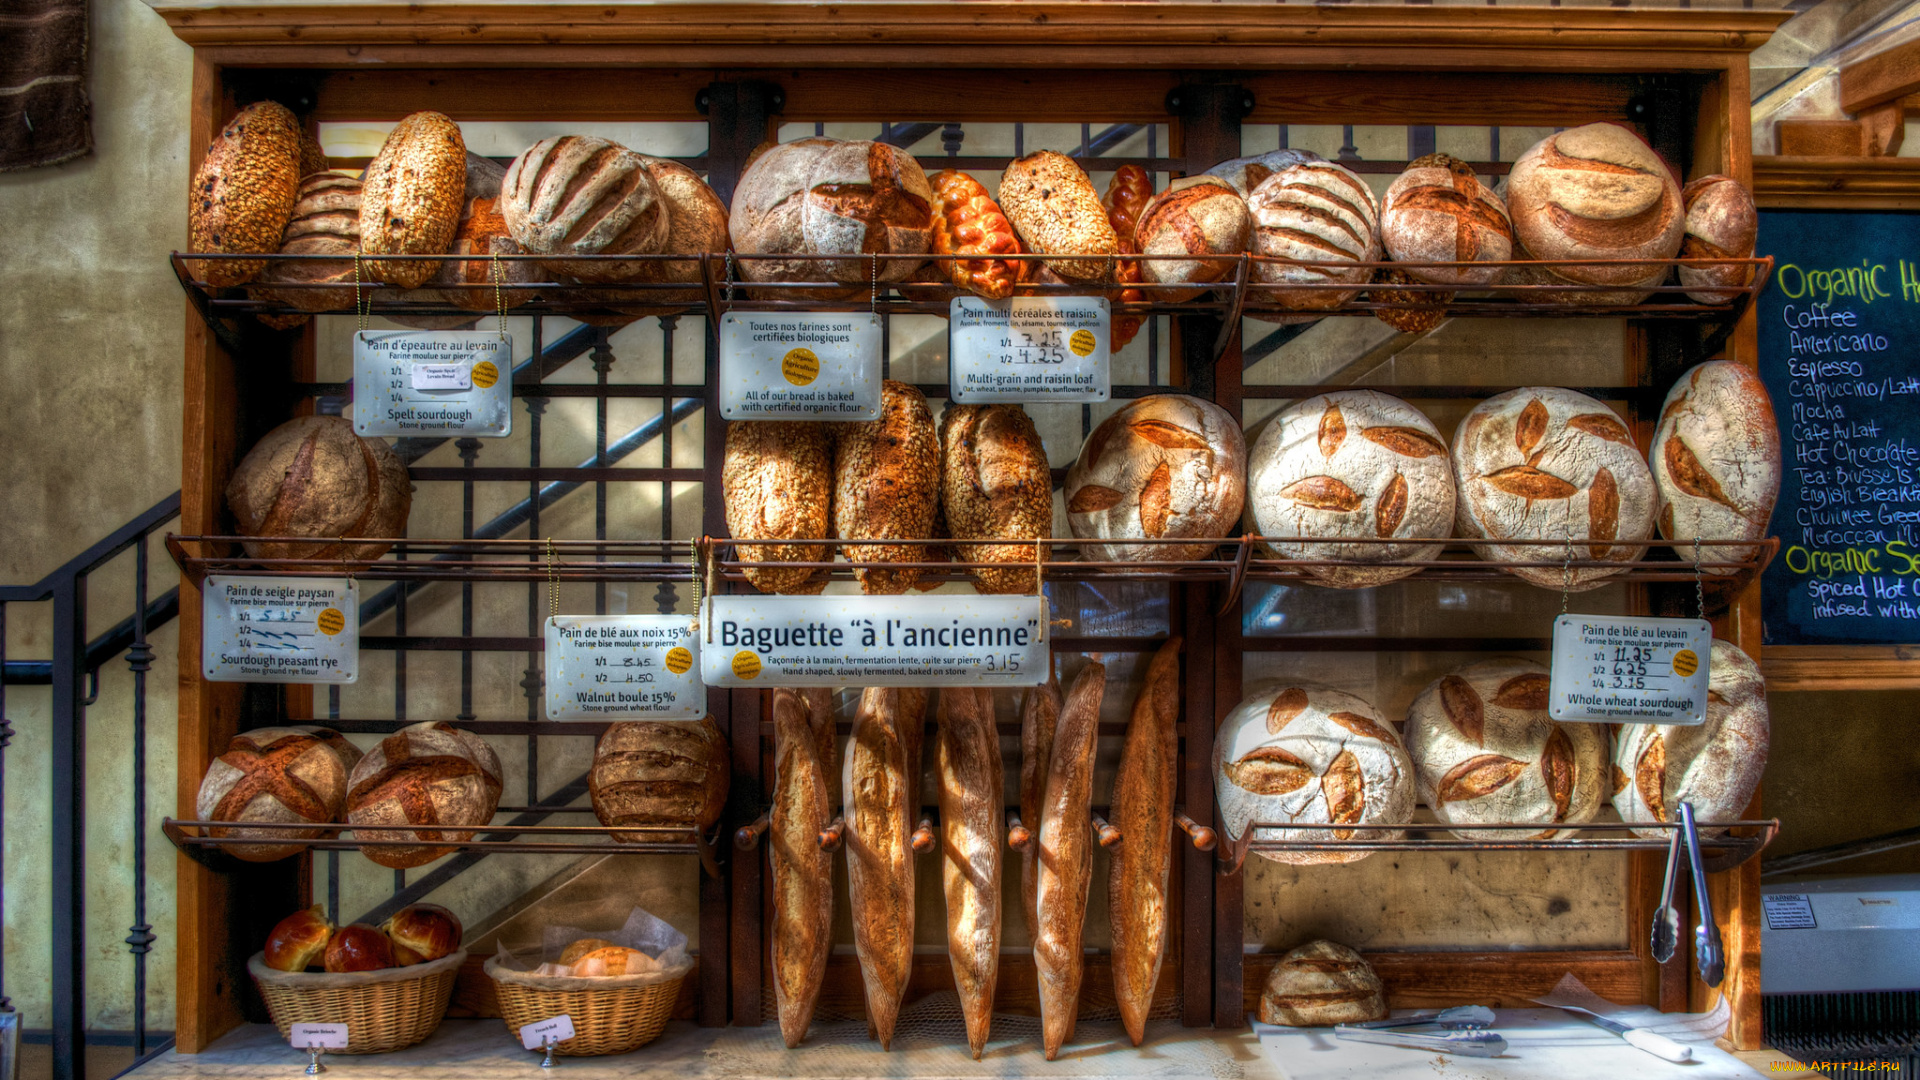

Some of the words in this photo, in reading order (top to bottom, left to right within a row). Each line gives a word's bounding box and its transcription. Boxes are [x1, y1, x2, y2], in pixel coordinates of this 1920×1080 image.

[1778, 258, 1890, 308] Organic
[963, 309, 983, 318] Pain
[986, 309, 1010, 318] multi
[1013, 309, 1052, 318] céréales
[1055, 310, 1063, 318] et
[1066, 310, 1097, 318] raisins
[1784, 303, 1857, 329] Coffee
[750, 322, 778, 331] Toutes
[799, 322, 830, 331] farines
[754, 333, 795, 342] certifiées
[798, 333, 849, 344] biologiques
[1790, 331, 1888, 355] Americano
[368, 340, 388, 350] Pain
[392, 340, 447, 352] d'épeautre
[450, 342, 462, 350] au
[466, 340, 497, 350] levain
[453, 352, 474, 361] pierre
[793, 353, 814, 363] Organic
[1019, 349, 1063, 363] 4.25
[785, 361, 817, 373] Agriculture
[1787, 358, 1862, 384] Espresso
[785, 370, 813, 381] Biologique
[967, 374, 1021, 385] Multi-grain
[1024, 375, 1042, 383] and
[1045, 375, 1071, 384] raisin
[1075, 374, 1093, 384] loaf
[391, 394, 402, 402] 1/4
[746, 392, 758, 400] All
[761, 391, 770, 400] of
[790, 392, 815, 400] bread
[818, 392, 825, 400] is
[828, 392, 854, 400] baked
[742, 403, 761, 411] with
[764, 403, 801, 411] certified
[804, 403, 836, 414] organic
[839, 403, 861, 412] flour
[1792, 402, 1844, 424] Mocha
[388, 409, 414, 421] Spelt
[417, 409, 472, 422] sourdough
[420, 422, 445, 430] ground
[1792, 423, 1830, 441] Cafe
[1833, 423, 1849, 439] Au
[1852, 419, 1881, 438] Lait
[1796, 441, 1828, 464] Hot
[1834, 437, 1919, 468] Chocolate
[1793, 467, 1831, 484] Tea:
[1801, 487, 1855, 510] English
[1802, 528, 1888, 548] Moroccan
[1786, 542, 1881, 580] Organic
[227, 586, 247, 595] Pain
[251, 586, 263, 596] de
[266, 587, 295, 598] seigle
[299, 589, 334, 599] paysan
[1808, 575, 1868, 602] Spiced
[1873, 576, 1906, 600] Hot
[1812, 599, 1872, 619] infused
[1877, 601, 1917, 619] with
[560, 628, 581, 638] Pain
[585, 628, 597, 638] de
[601, 627, 616, 638] blé
[620, 629, 639, 638] aux
[642, 628, 664, 638] noix
[668, 627, 691, 639] 15%
[723, 621, 843, 653] Baguette
[1583, 625, 1604, 635] Pain
[1607, 626, 1619, 636] de
[1623, 626, 1639, 637] blé
[1641, 629, 1653, 637] au
[1657, 628, 1687, 638] levain
[655, 640, 676, 648] pierre
[1615, 647, 1652, 661] 11.25
[222, 654, 275, 667] Sourdough
[279, 656, 319, 667] peasant
[322, 658, 337, 669] rye
[623, 658, 651, 667] 8.45
[768, 656, 804, 666] Façonnée
[807, 656, 811, 664] à
[813, 656, 820, 664] la
[823, 656, 844, 665] main,
[846, 656, 897, 664] fermentation
[899, 656, 920, 664] lente,
[922, 656, 941, 664] cuite
[958, 657, 981, 666] pierre
[985, 654, 1020, 671] 3.15
[805, 668, 835, 676] shaped,
[837, 668, 861, 676] slowly
[864, 668, 906, 676] fermented,
[1593, 666, 1605, 674] 1/2
[1613, 662, 1647, 675] 6.25
[626, 673, 653, 682] 4.50
[1613, 677, 1645, 689] 3.15
[577, 692, 615, 702] Walnut
[619, 692, 648, 702] boule
[652, 692, 675, 704] 15%
[1568, 694, 1601, 705] Whole
[1605, 696, 1636, 706] wheat
[1640, 697, 1693, 711] sourdough
[604, 704, 628, 712] ground
[1608, 708, 1632, 716] ground
